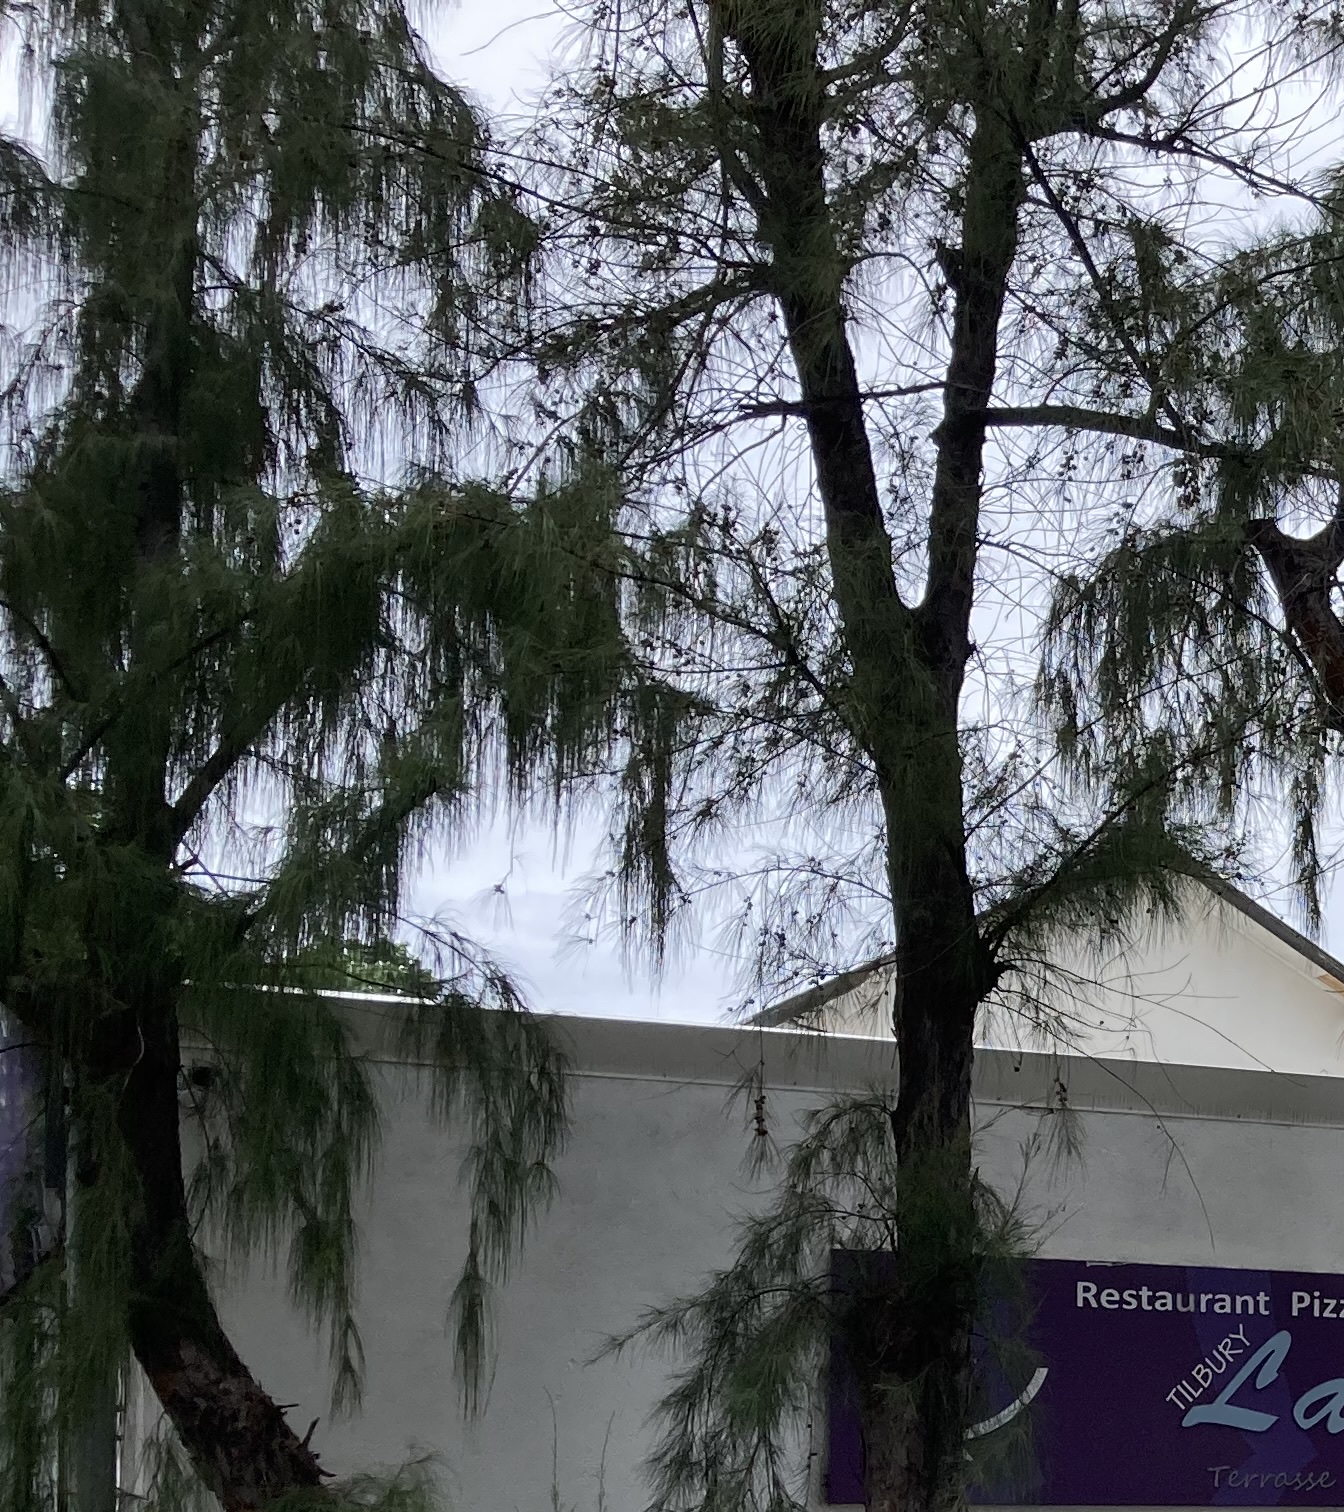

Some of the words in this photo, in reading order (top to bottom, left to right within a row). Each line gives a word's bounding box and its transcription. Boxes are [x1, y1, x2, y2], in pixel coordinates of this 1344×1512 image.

[1076, 1281, 1270, 1315] Restaurant
[1165, 1323, 1251, 1410] TILBURY
[1207, 1464, 1337, 1492] Terrasse
